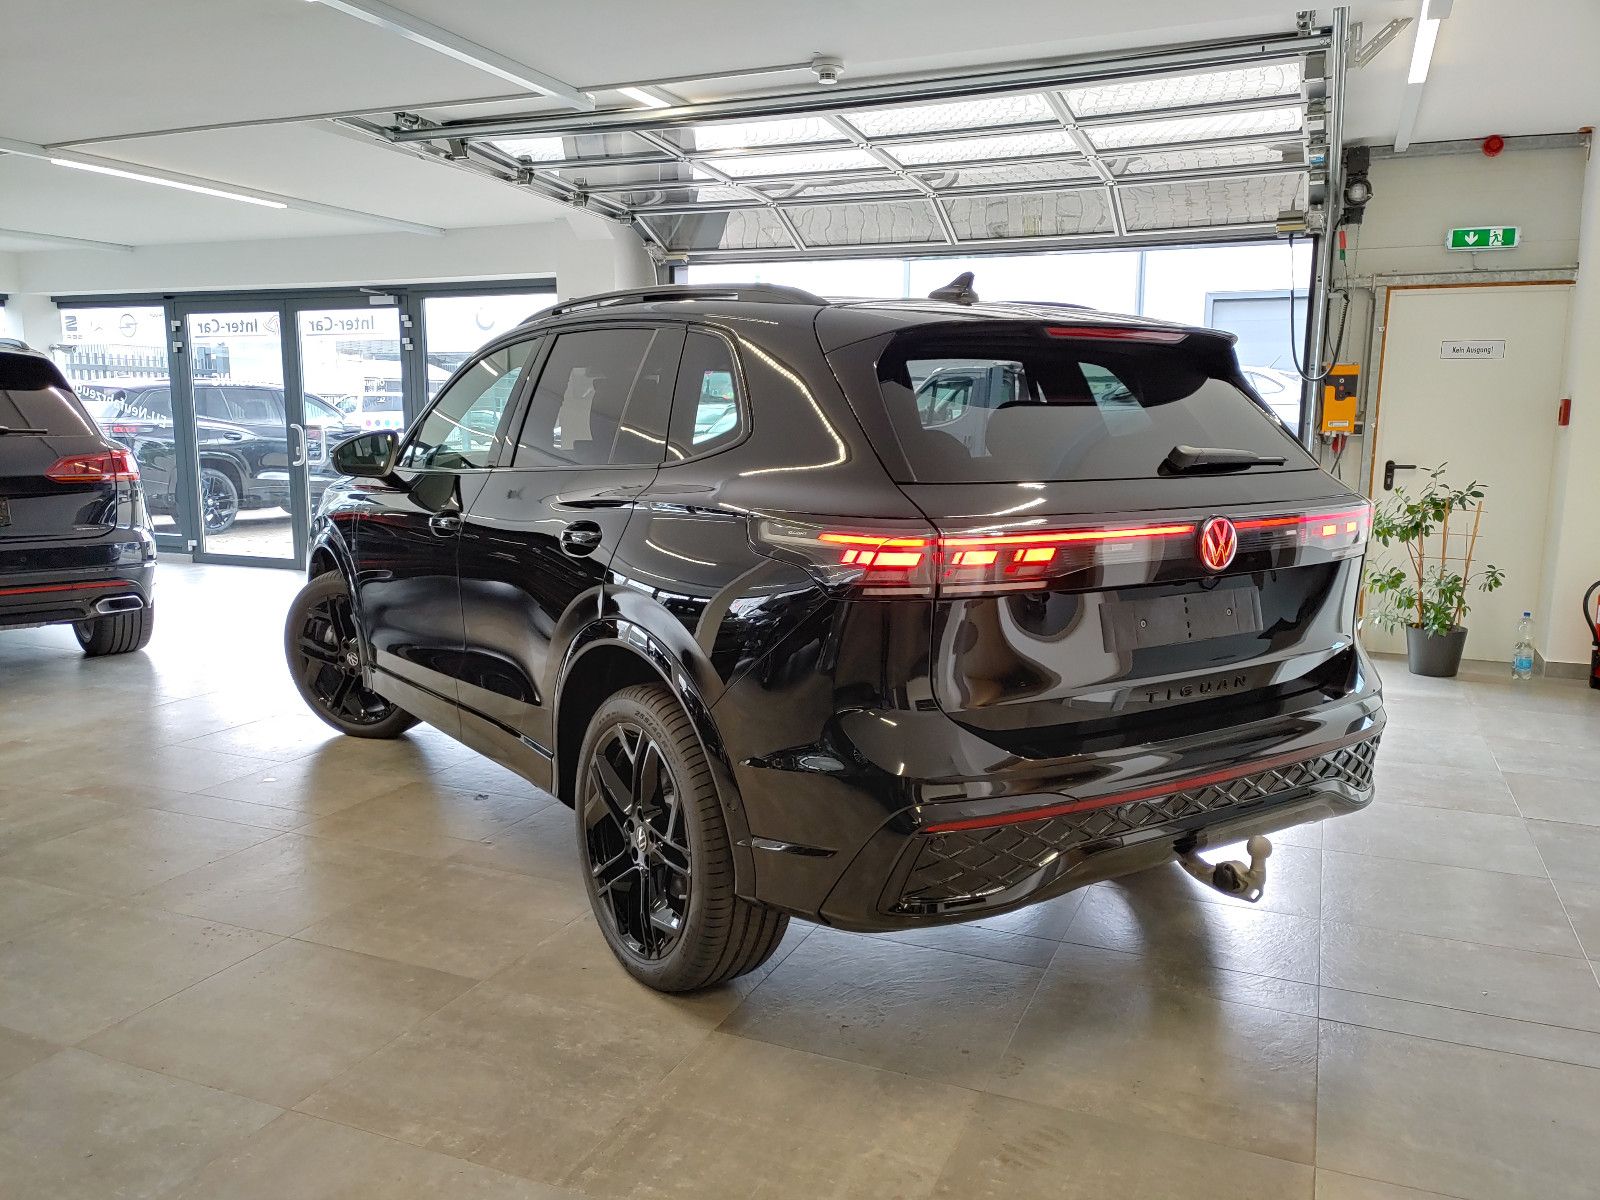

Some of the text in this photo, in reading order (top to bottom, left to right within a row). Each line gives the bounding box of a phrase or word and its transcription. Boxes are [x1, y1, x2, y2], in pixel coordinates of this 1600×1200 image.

[1452, 346, 1494, 354] Kein Ausgang!
[1146, 675, 1247, 704] TIGUAN
